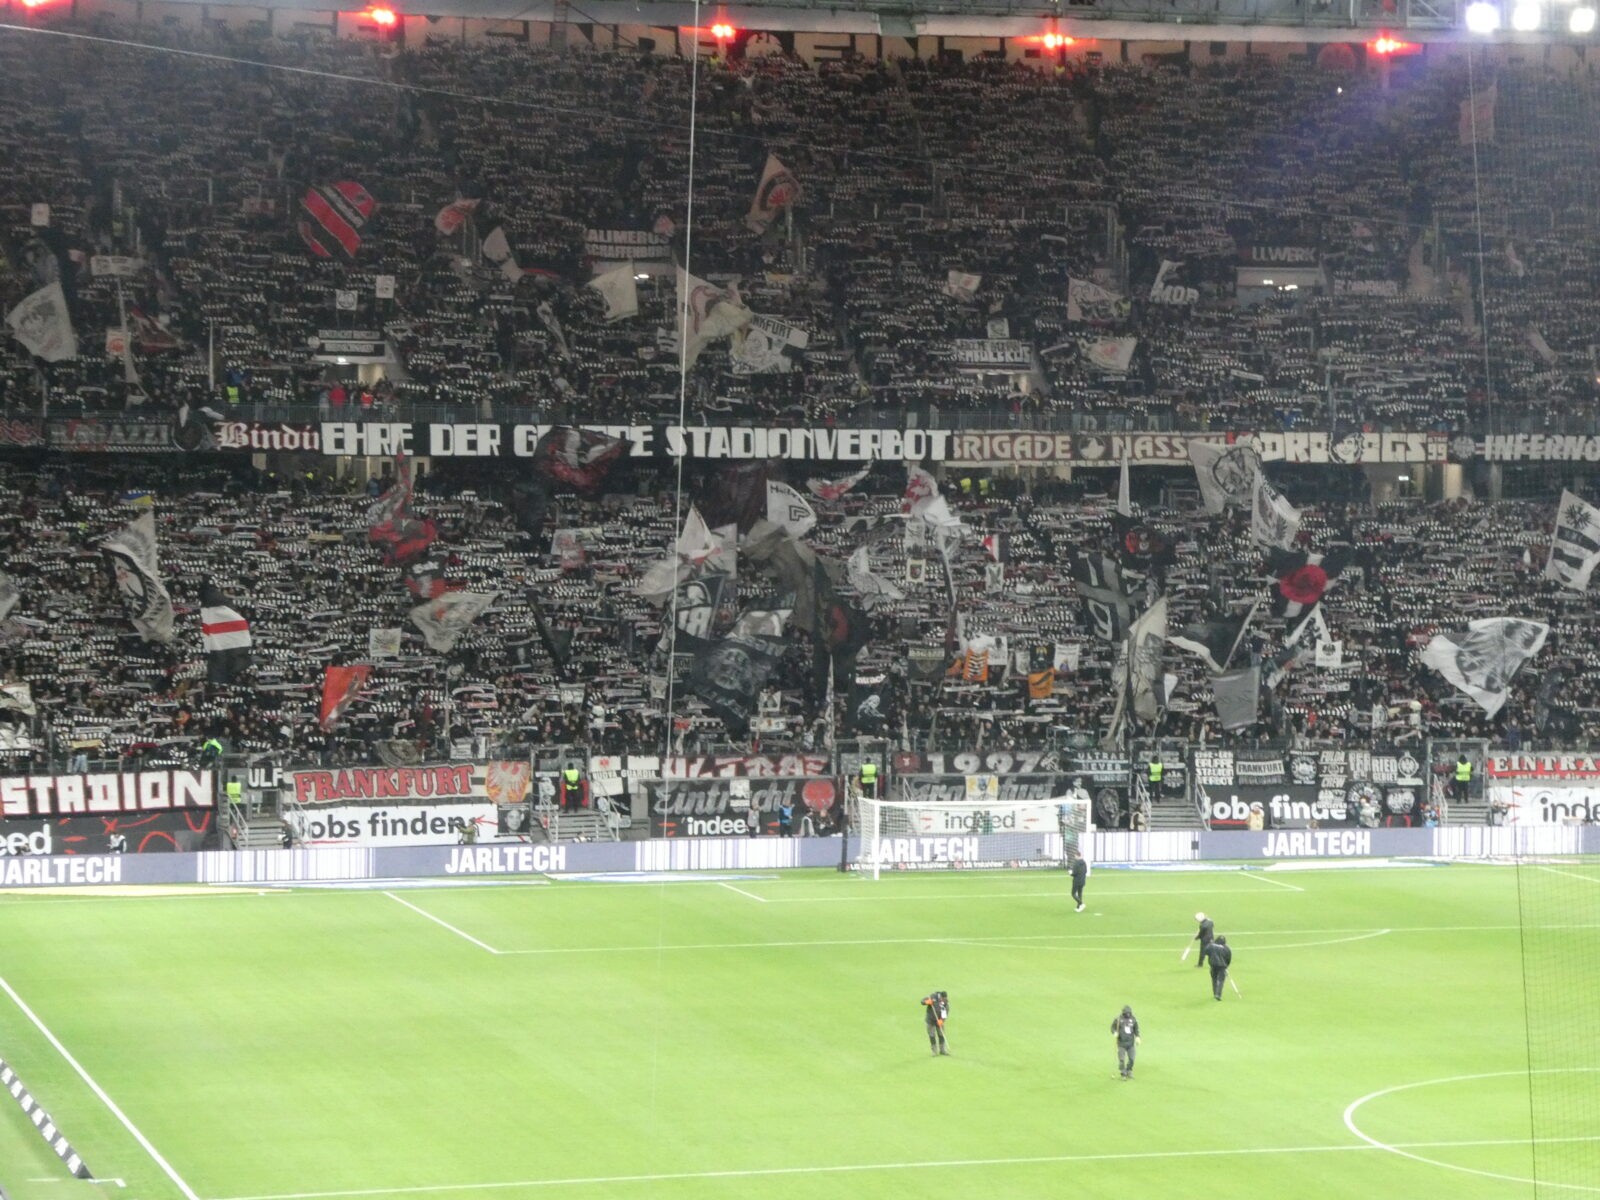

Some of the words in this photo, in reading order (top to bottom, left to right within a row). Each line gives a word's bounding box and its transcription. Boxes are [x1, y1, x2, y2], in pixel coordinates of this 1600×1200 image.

[320, 422, 413, 456] EHRE
[429, 424, 501, 456] DER
[665, 425, 952, 461] STADIONVERBOT
[953, 434, 1072, 462] BRIGADE
[1484, 433, 1600, 461] INFERNO
[661, 755, 828, 779] ULTRAS
[927, 752, 1040, 774] 1997
[1077, 752, 1125, 760] ULTRAS
[1082, 762, 1122, 770] NEVER
[1237, 762, 1283, 773] FRANKFURT
[1371, 758, 1398, 772] RIED
[1, 769, 213, 815] STADION
[293, 764, 475, 803] FRANKFURT
[653, 780, 797, 815] Eintrcht
[686, 815, 761, 836] indee
[1262, 831, 1371, 857] JARLTECH
[444, 845, 566, 874] JARLTECH
